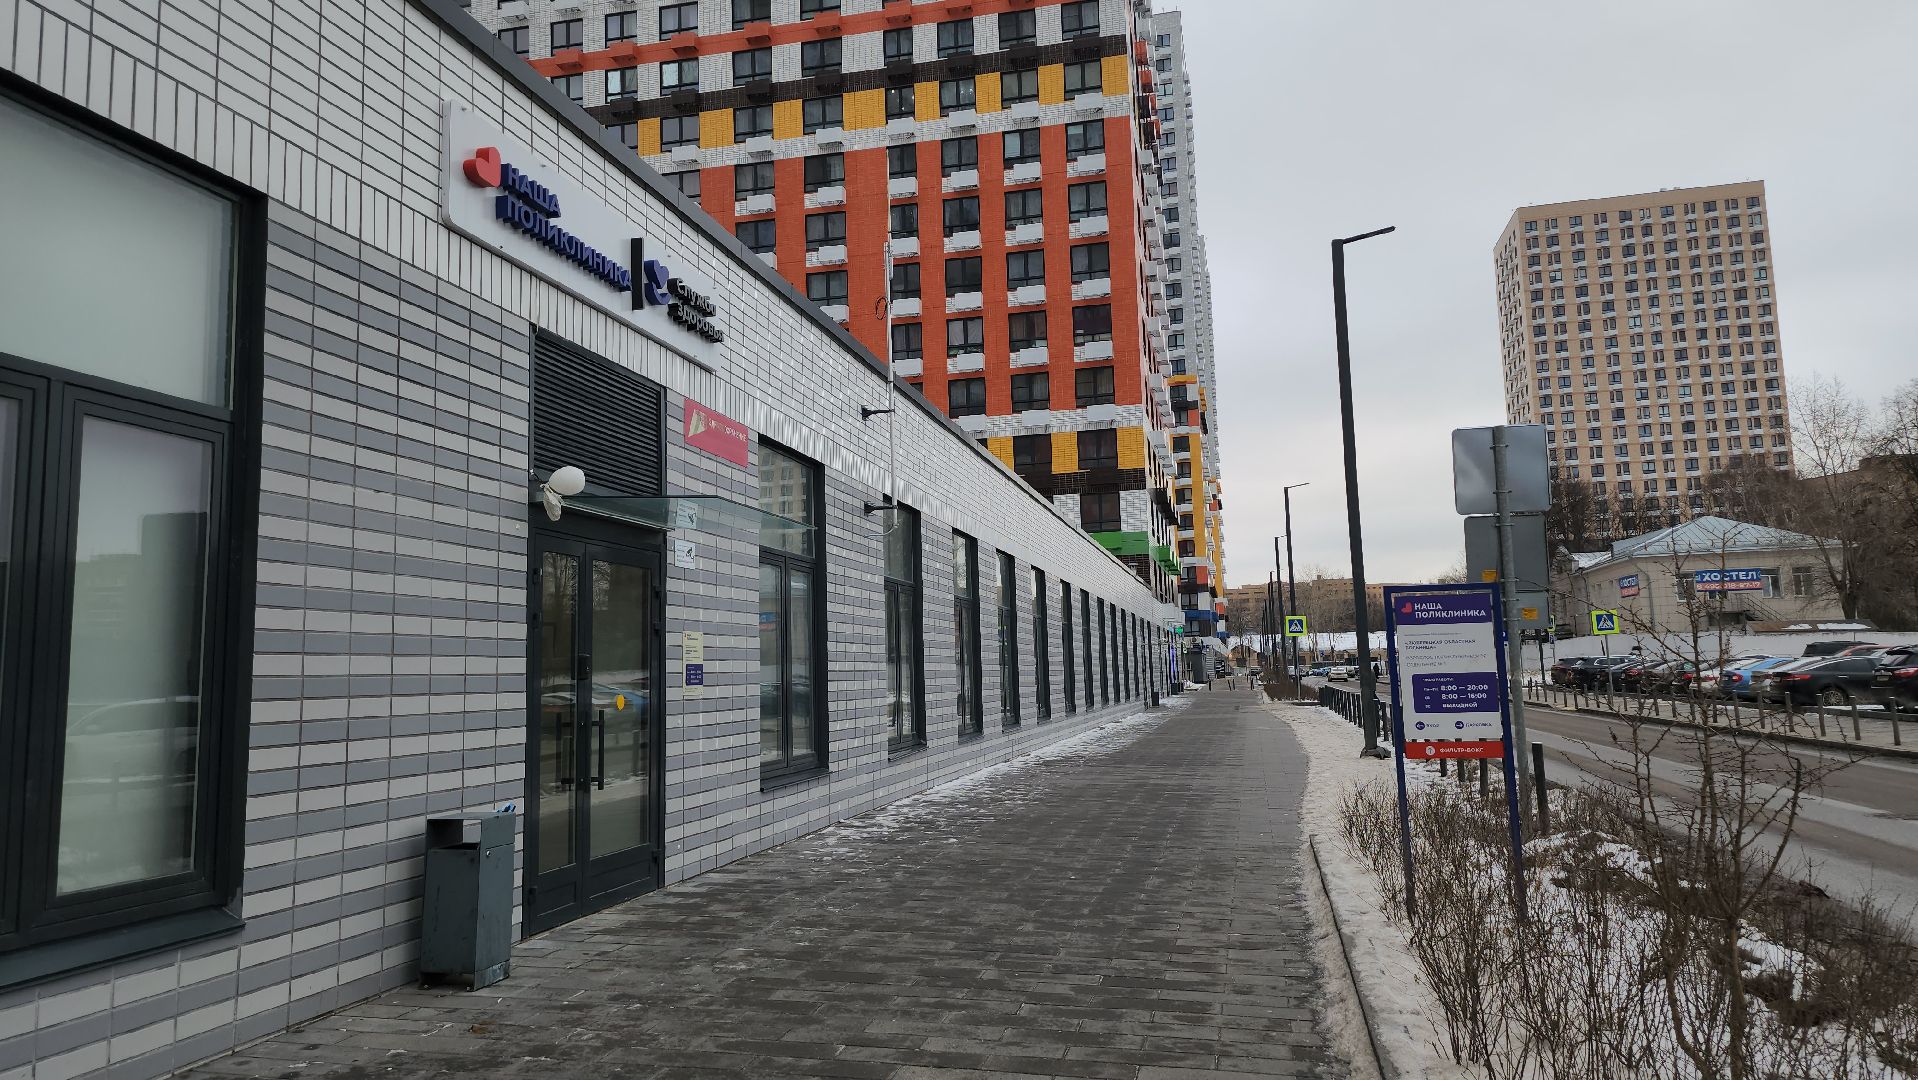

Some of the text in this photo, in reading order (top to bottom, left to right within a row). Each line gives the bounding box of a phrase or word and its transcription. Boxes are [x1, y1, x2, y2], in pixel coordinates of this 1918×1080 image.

[502, 163, 561, 218] НАША
[497, 194, 631, 292] ПОЛИКЛИНИКА
[668, 278, 717, 318] Служба
[668, 303, 725, 344] здоровья
[1702, 571, 1757, 582] ХОСТЕЛ
[1414, 602, 1443, 611] НАША
[1415, 609, 1487, 619] ПОЛИКЛИНИКА
